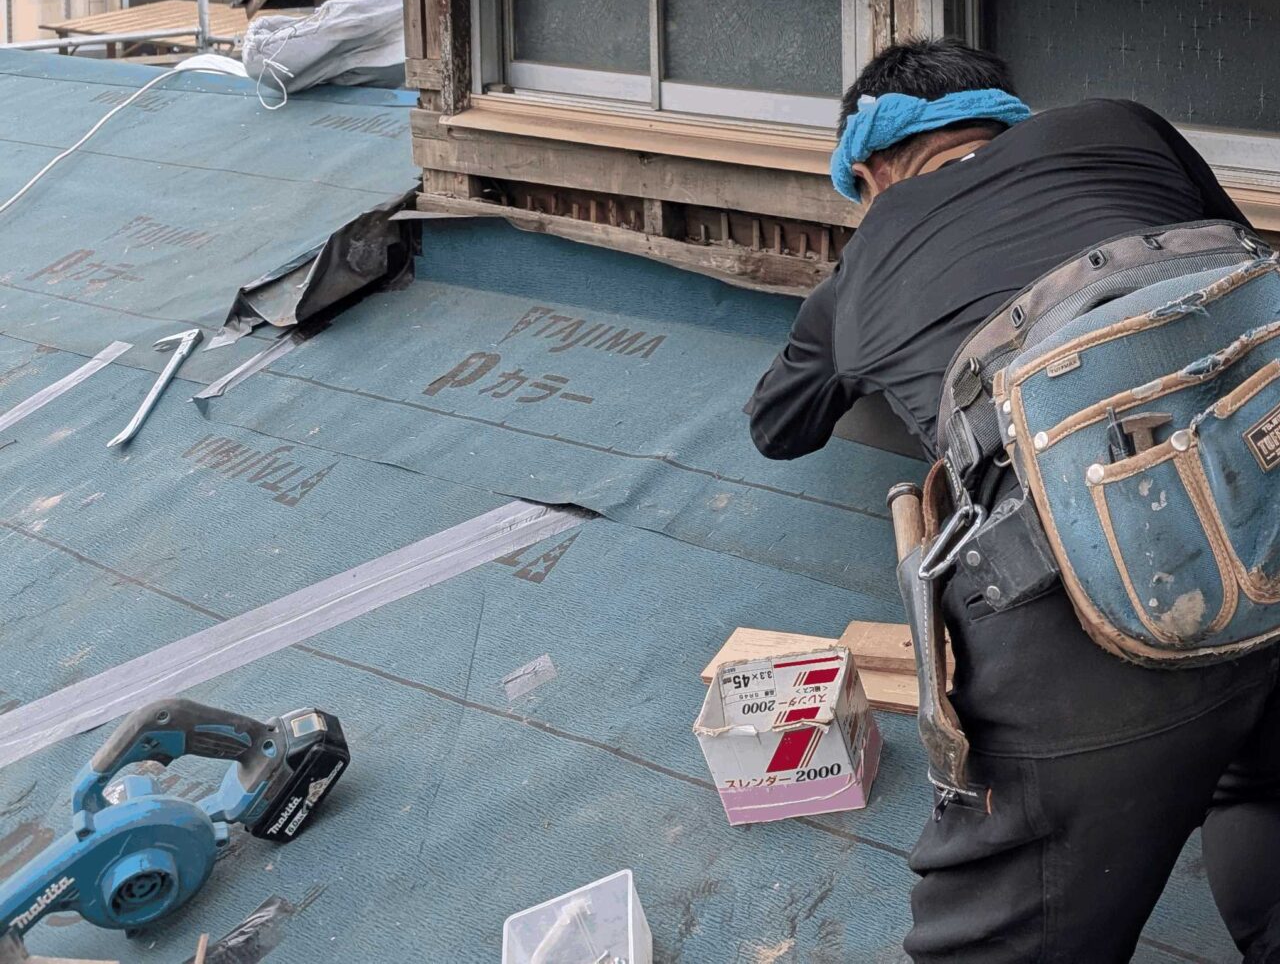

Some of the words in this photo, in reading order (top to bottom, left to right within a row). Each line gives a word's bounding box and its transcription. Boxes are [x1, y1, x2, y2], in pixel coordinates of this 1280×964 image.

[534, 314, 667, 359] TAJIMA
[742, 699, 776, 716] 2000
[779, 693, 827, 708] スレンダー
[796, 763, 842, 782] 2000
